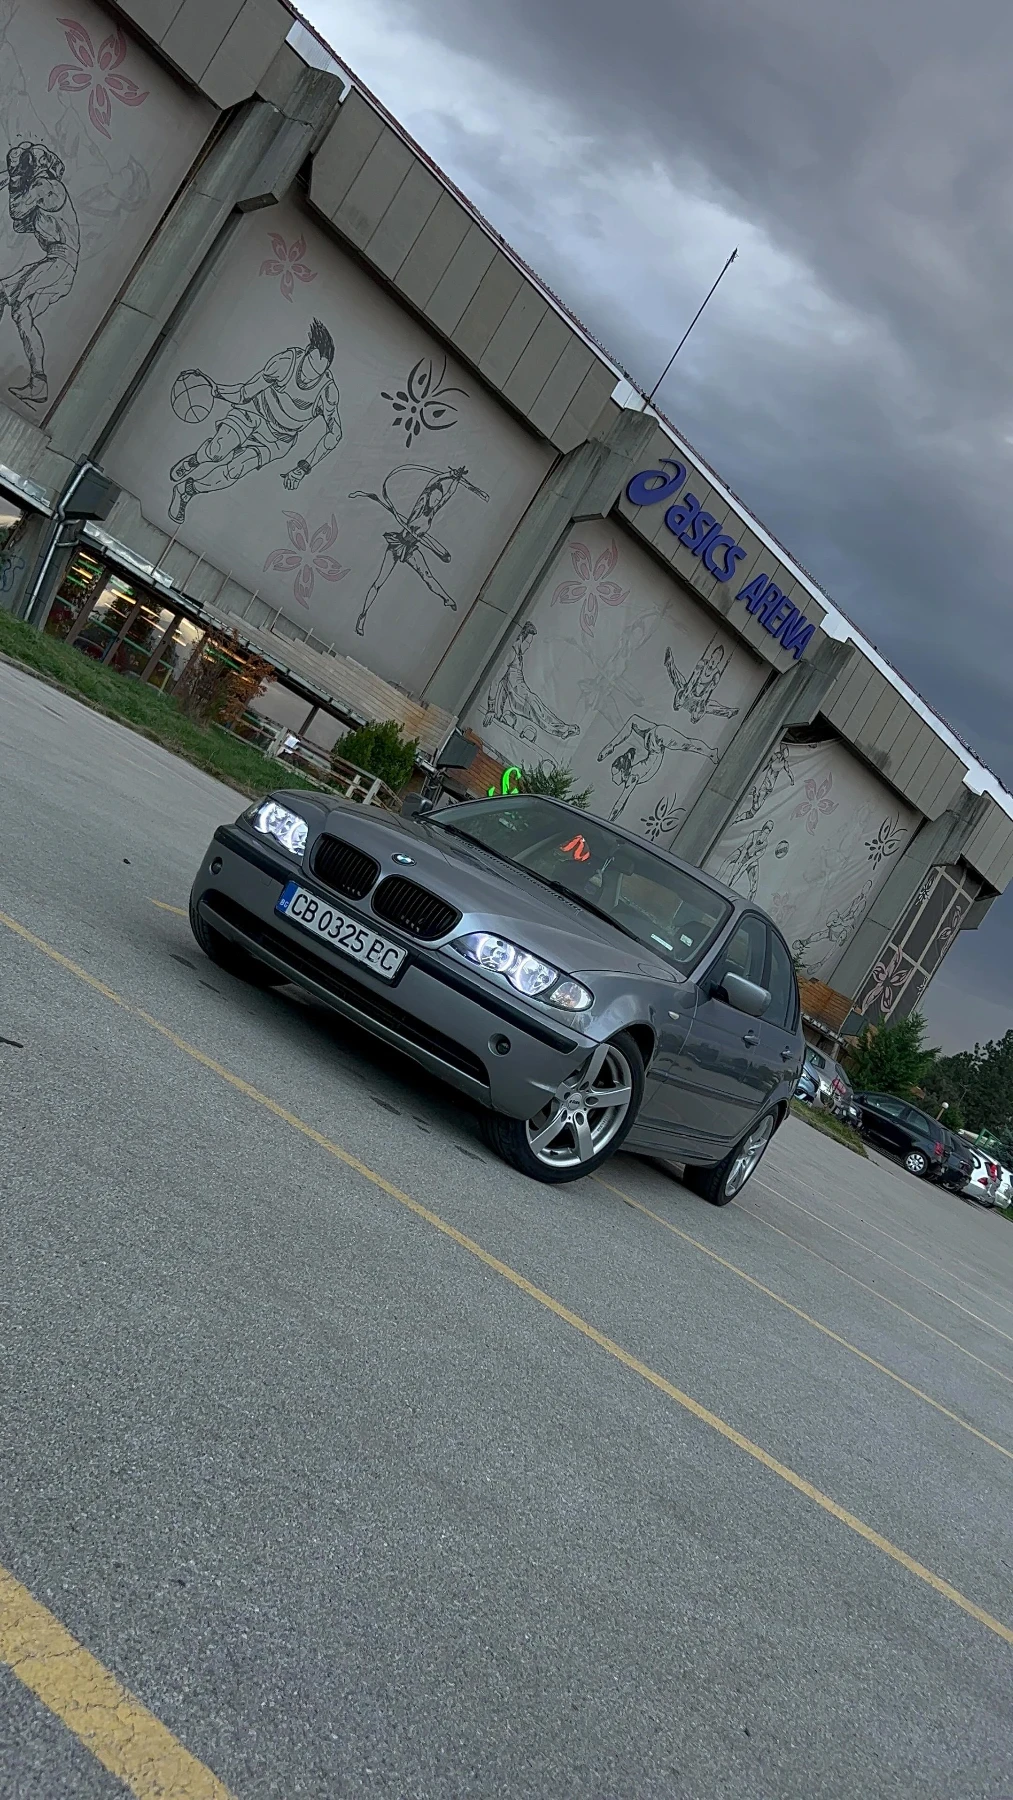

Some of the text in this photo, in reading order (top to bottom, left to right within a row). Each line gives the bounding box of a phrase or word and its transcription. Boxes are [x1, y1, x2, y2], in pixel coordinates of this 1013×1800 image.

[735, 572, 816, 660] ARENA
[280, 898, 289, 908] BG
[291, 893, 319, 923] CB
[317, 910, 369, 953] 0325
